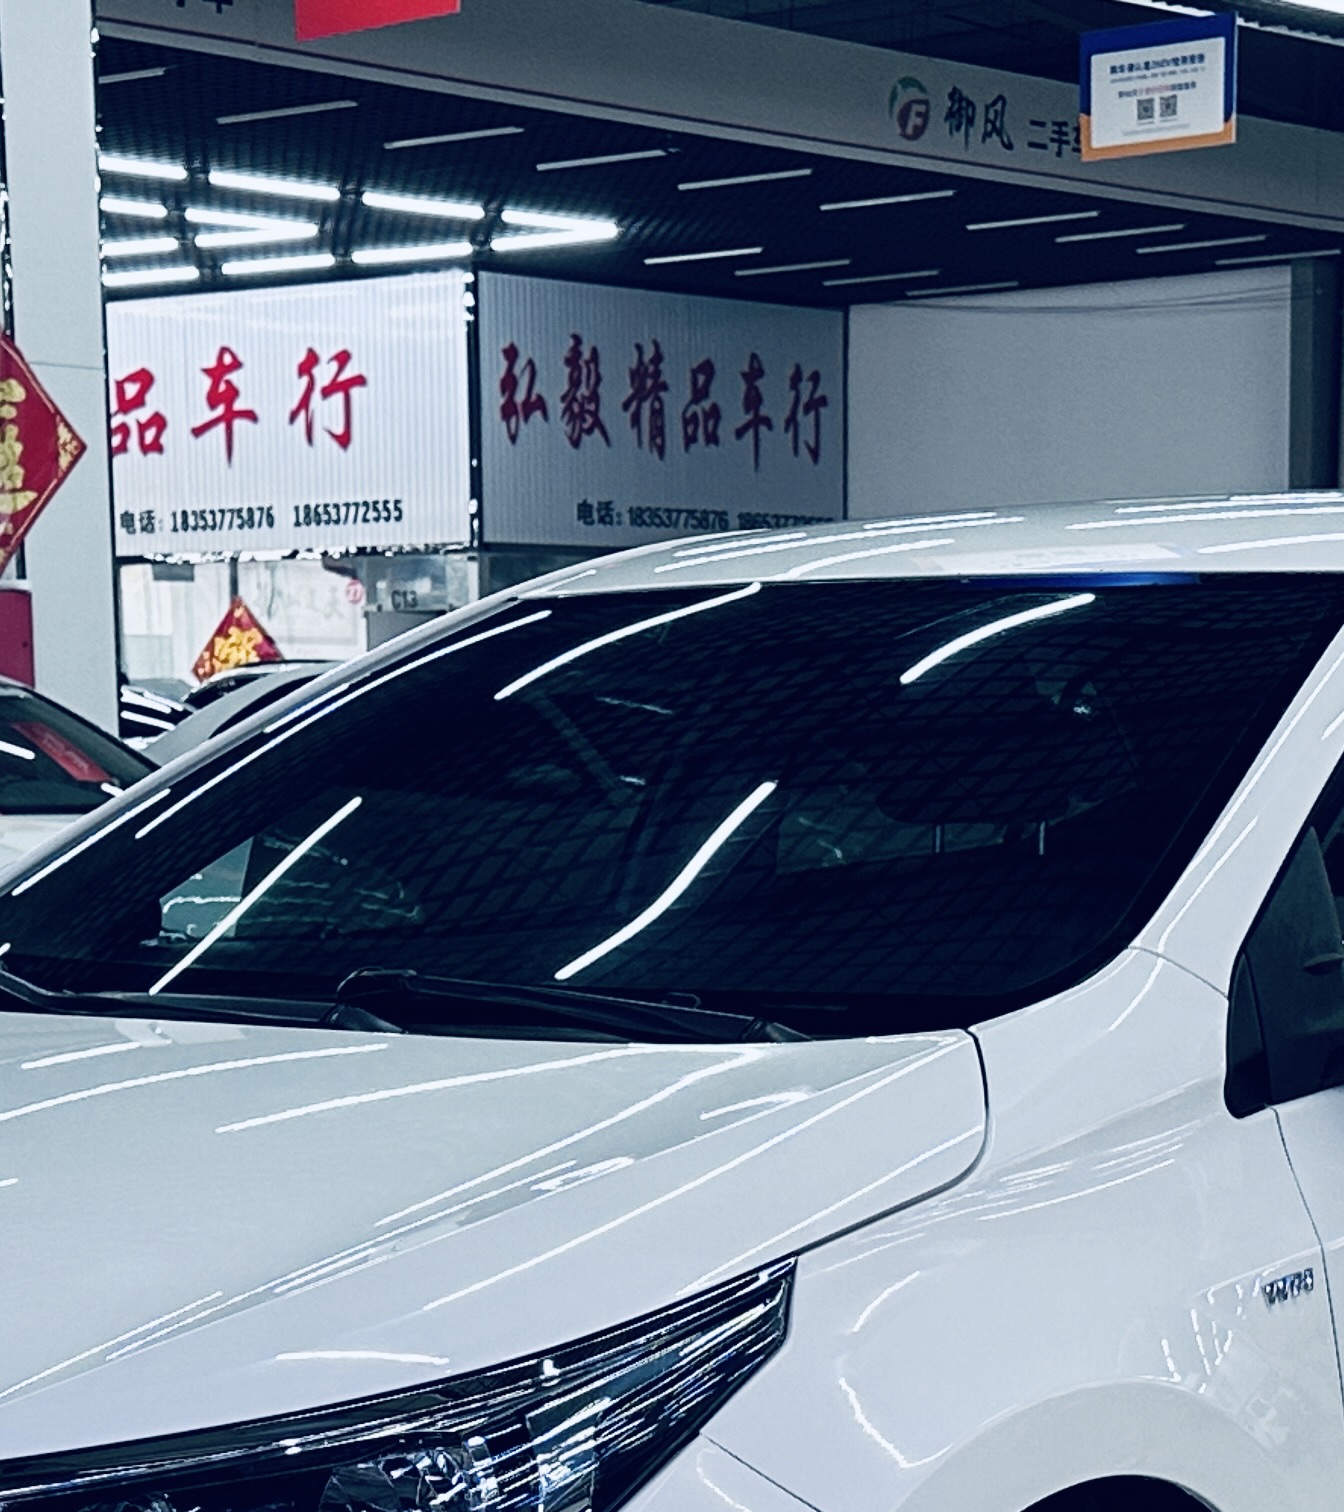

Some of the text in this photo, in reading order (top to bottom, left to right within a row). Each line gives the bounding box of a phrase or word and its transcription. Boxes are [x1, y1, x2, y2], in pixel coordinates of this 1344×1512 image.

[944, 86, 1014, 151] 御风
[500, 333, 829, 472] 弘毅精品车行
